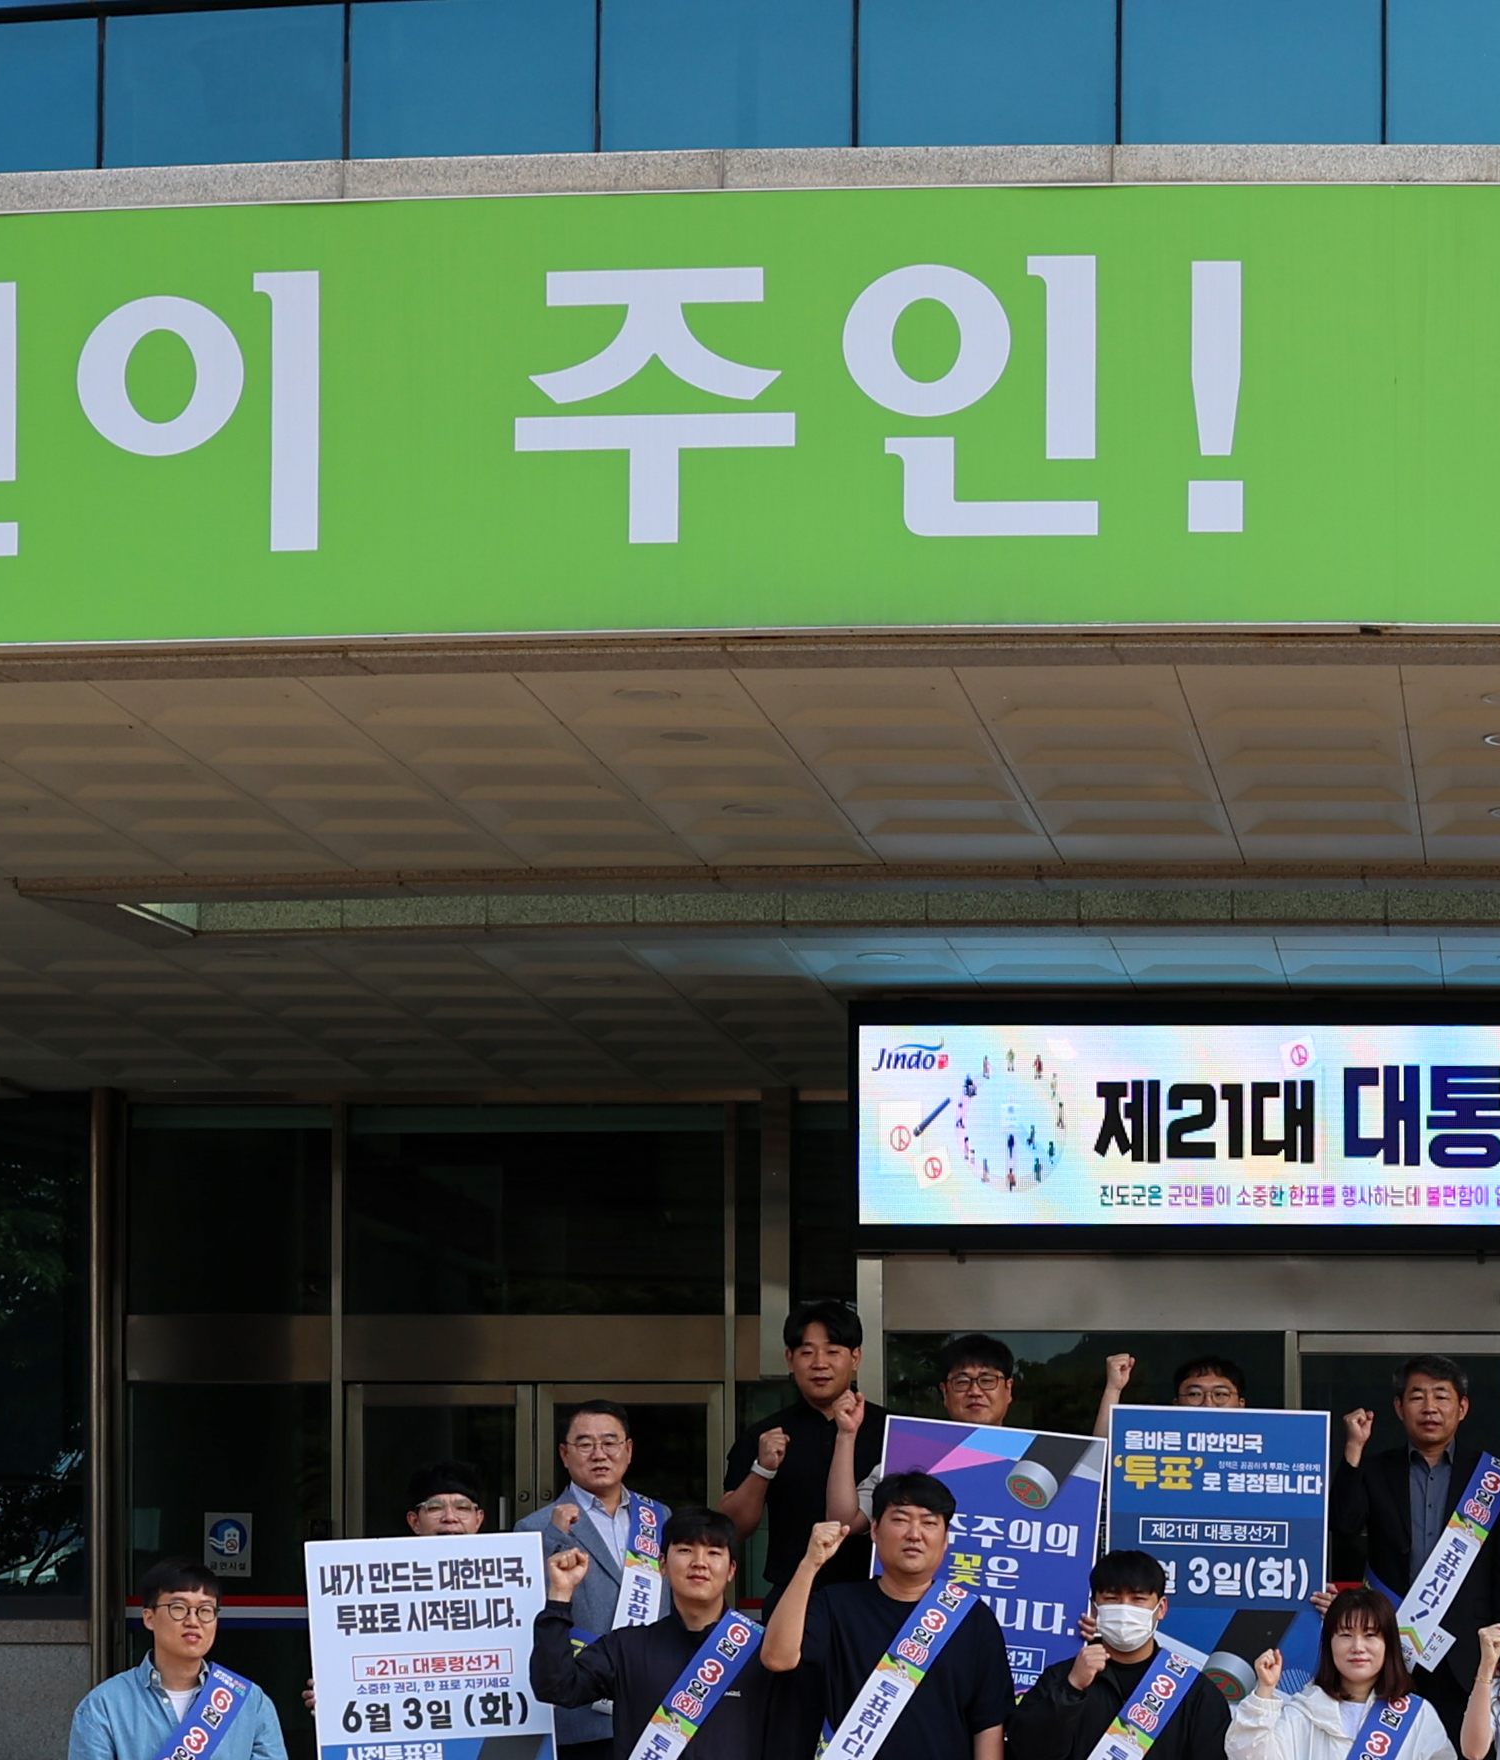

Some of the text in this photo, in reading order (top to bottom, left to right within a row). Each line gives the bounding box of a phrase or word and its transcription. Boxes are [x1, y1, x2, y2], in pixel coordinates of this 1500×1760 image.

[514, 255, 1246, 545] 주인!
[872, 1046, 936, 1071] Jindo
[1094, 1080, 1315, 1163] 제21대
[1100, 1185, 1162, 1207] 진도군은
[1168, 1185, 1231, 1207] 군민들이
[1236, 1185, 1285, 1207] 소중한
[1288, 1185, 1336, 1207] 한표를
[1342, 1185, 1420, 1207] 행사하는데
[1427, 1185, 1490, 1207] 불편함이
[1124, 1430, 1263, 1454] 올바른 대한민국
[1227, 1472, 1323, 1496] 결정됩니다
[1151, 1523, 1277, 1543] 제21대 대통령선거
[319, 1556, 532, 1596] 내가 만드는 대한민국,
[1188, 1557, 1309, 1600] 3일(화)
[1410, 1537, 1469, 1623] 투표합시다!
[337, 1597, 521, 1636] 투표로 시작됩니다.
[981, 1595, 1076, 1636] 니다.
[716, 1622, 750, 1661] 6월
[897, 1608, 947, 1665] 3일(화)
[365, 1654, 500, 1676] 제21대 대통령선거
[357, 1677, 510, 1695] 소중한 권리, 한 표로 지키세요
[671, 1658, 725, 1719] 3일(화)
[1128, 1674, 1177, 1732] 3일(화)
[201, 1686, 233, 1730] 6월
[342, 1692, 529, 1734] 6월 3일 (화)
